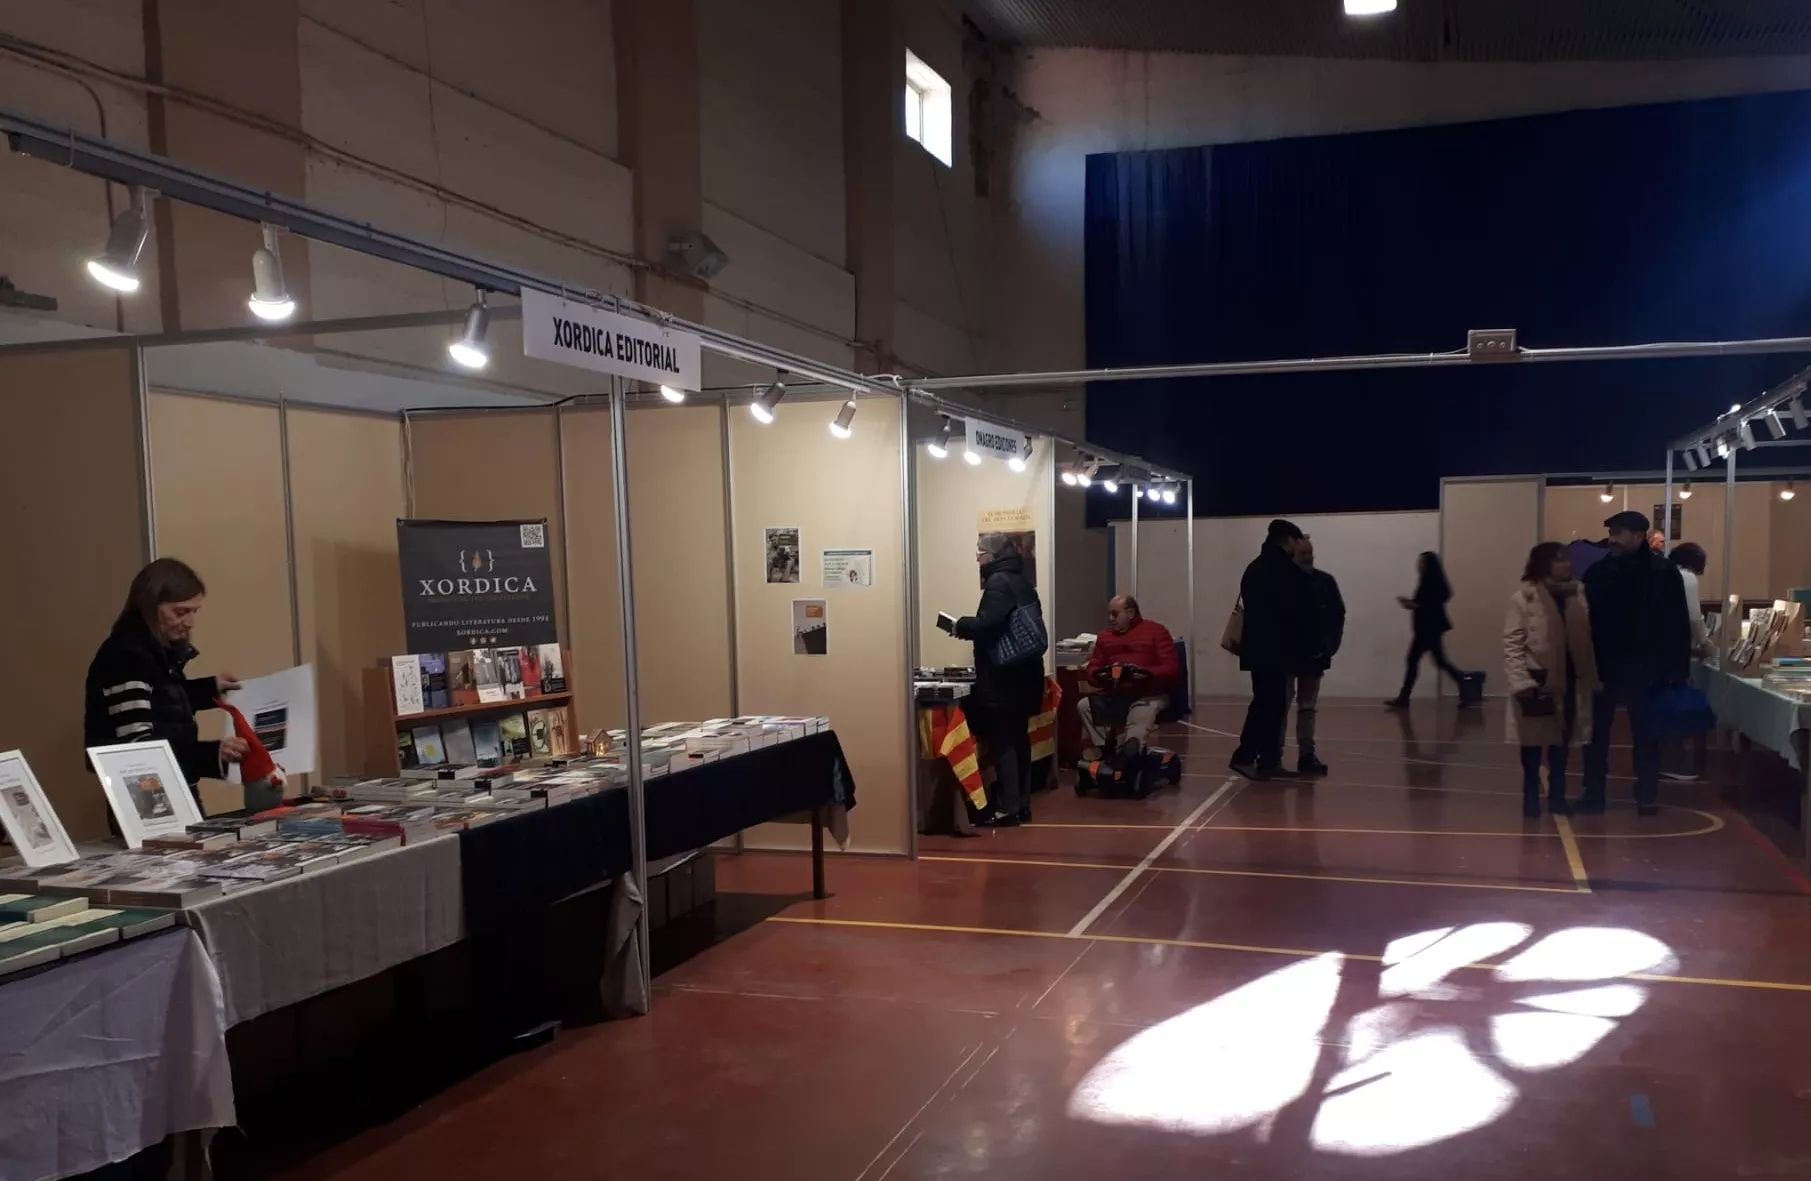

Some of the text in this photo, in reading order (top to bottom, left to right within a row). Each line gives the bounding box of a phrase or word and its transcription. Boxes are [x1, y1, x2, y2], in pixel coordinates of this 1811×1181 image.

[552, 316, 680, 373] XORDICA EDITORIAL
[995, 435, 1016, 453] EDICIONES
[419, 576, 537, 596] XORDICA
[411, 620, 459, 628] PUBLICANDO
[461, 618, 506, 626] LITERATURA
[507, 616, 530, 624] DESDE
[456, 627, 509, 636] XORDICA.COM
